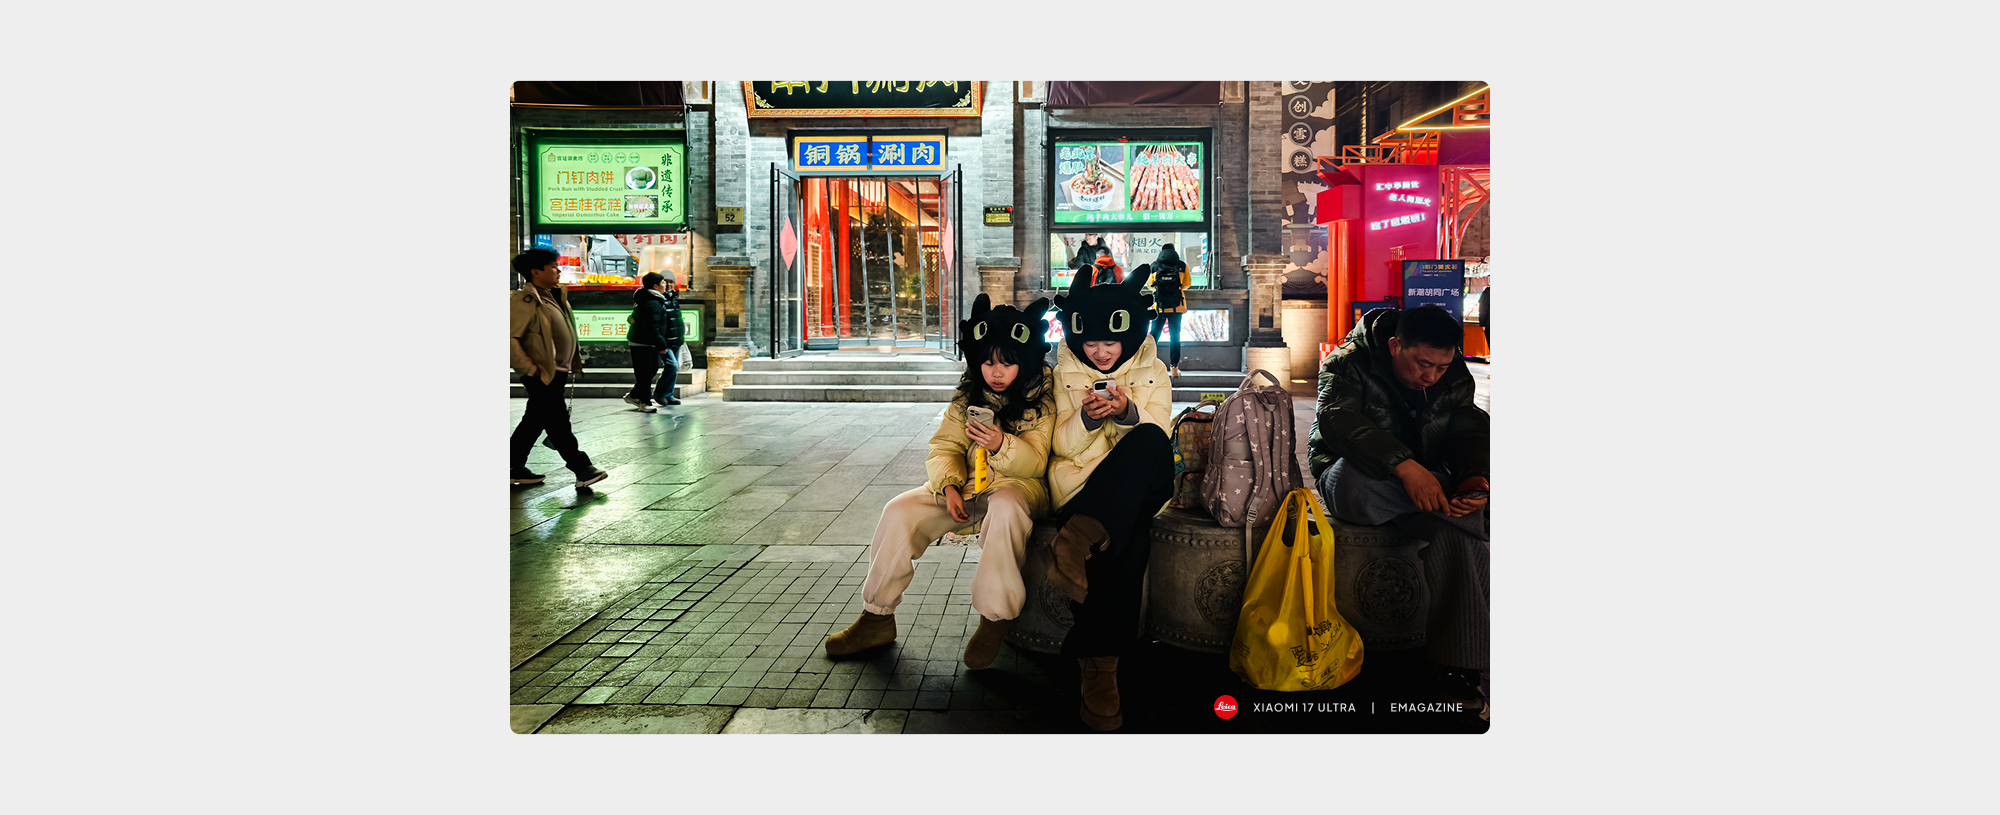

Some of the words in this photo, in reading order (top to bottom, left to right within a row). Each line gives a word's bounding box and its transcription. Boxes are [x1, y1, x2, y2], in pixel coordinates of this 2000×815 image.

[804, 143, 935, 166] 铜锅涮肉
[557, 171, 614, 185] 门钉肉饼
[660, 153, 674, 213] 非遗传承
[550, 198, 622, 212] 宫廷桂花糕
[725, 213, 736, 222] 52
[1132, 237, 1162, 248] 烟火
[1408, 288, 1460, 297] 新潮胡同广场
[579, 324, 590, 336] 饼
[601, 324, 627, 336] 宫廷
